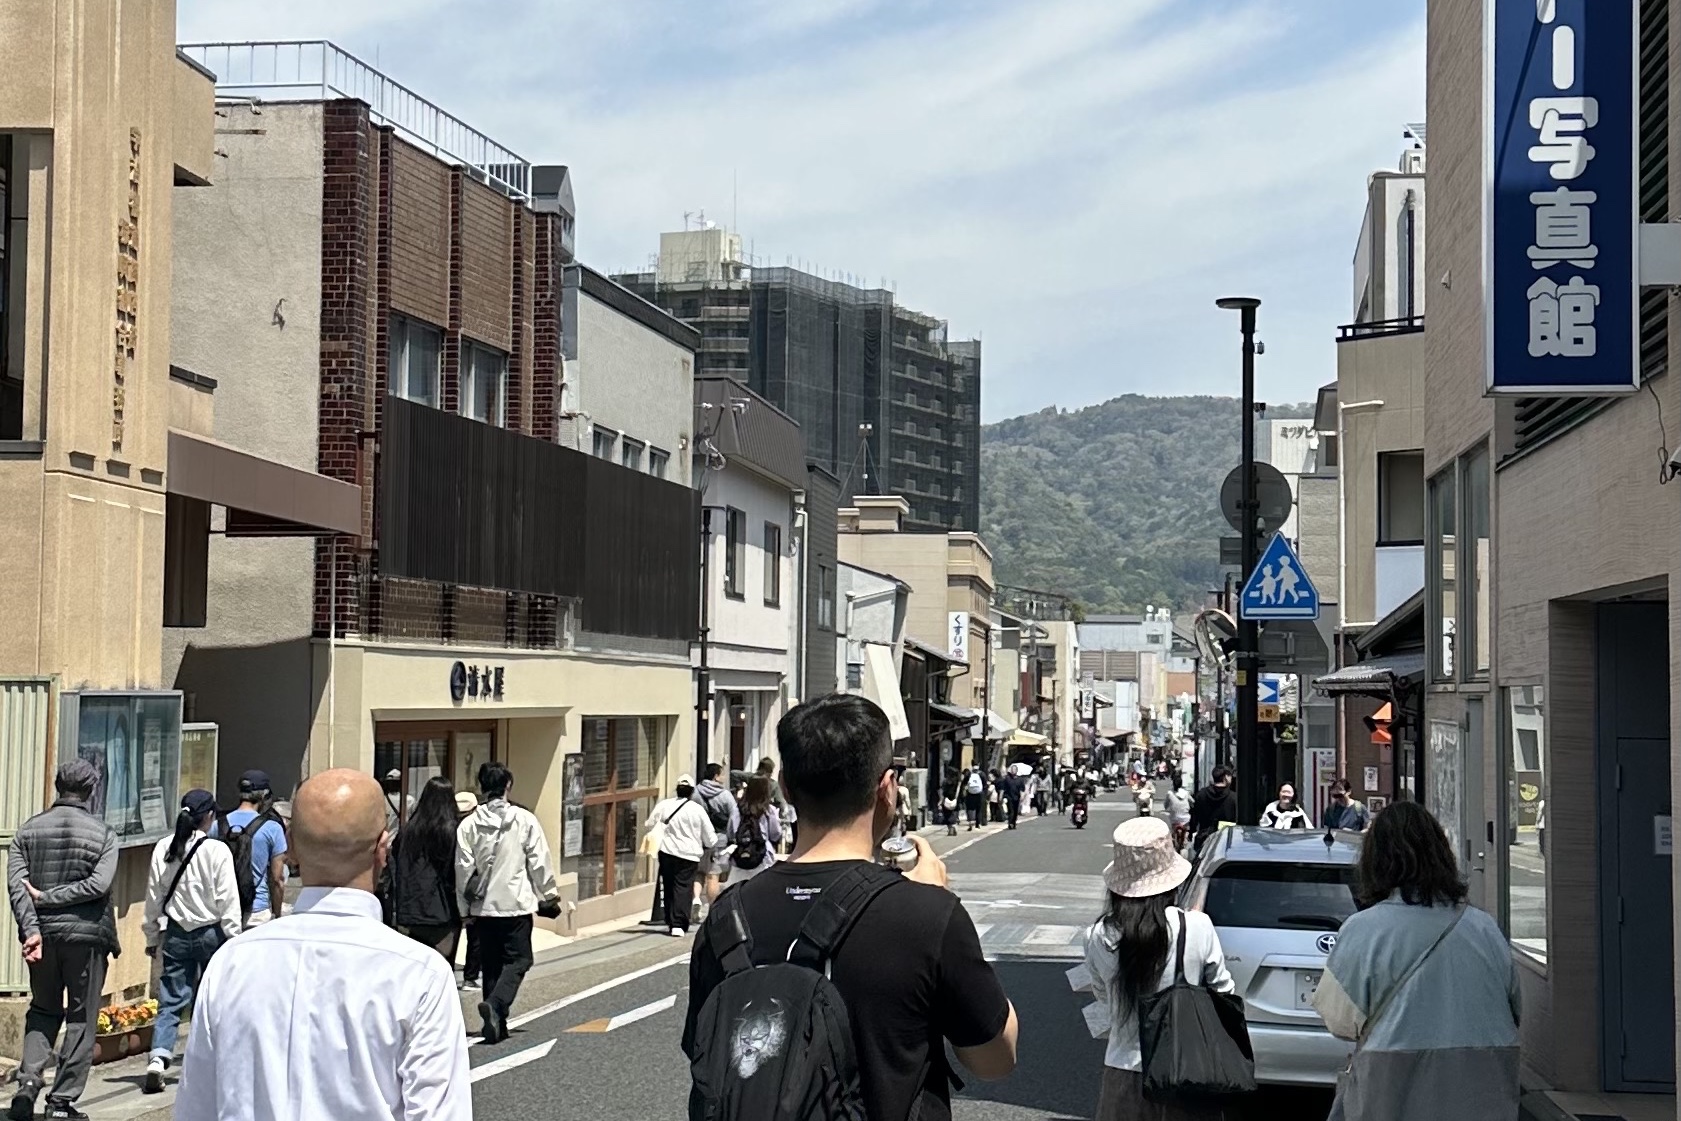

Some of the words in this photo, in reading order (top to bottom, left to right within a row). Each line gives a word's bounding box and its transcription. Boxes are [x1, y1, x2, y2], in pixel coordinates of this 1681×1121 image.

[1527, 0, 1600, 357] ー写真館
[953, 614, 963, 646] くすり
